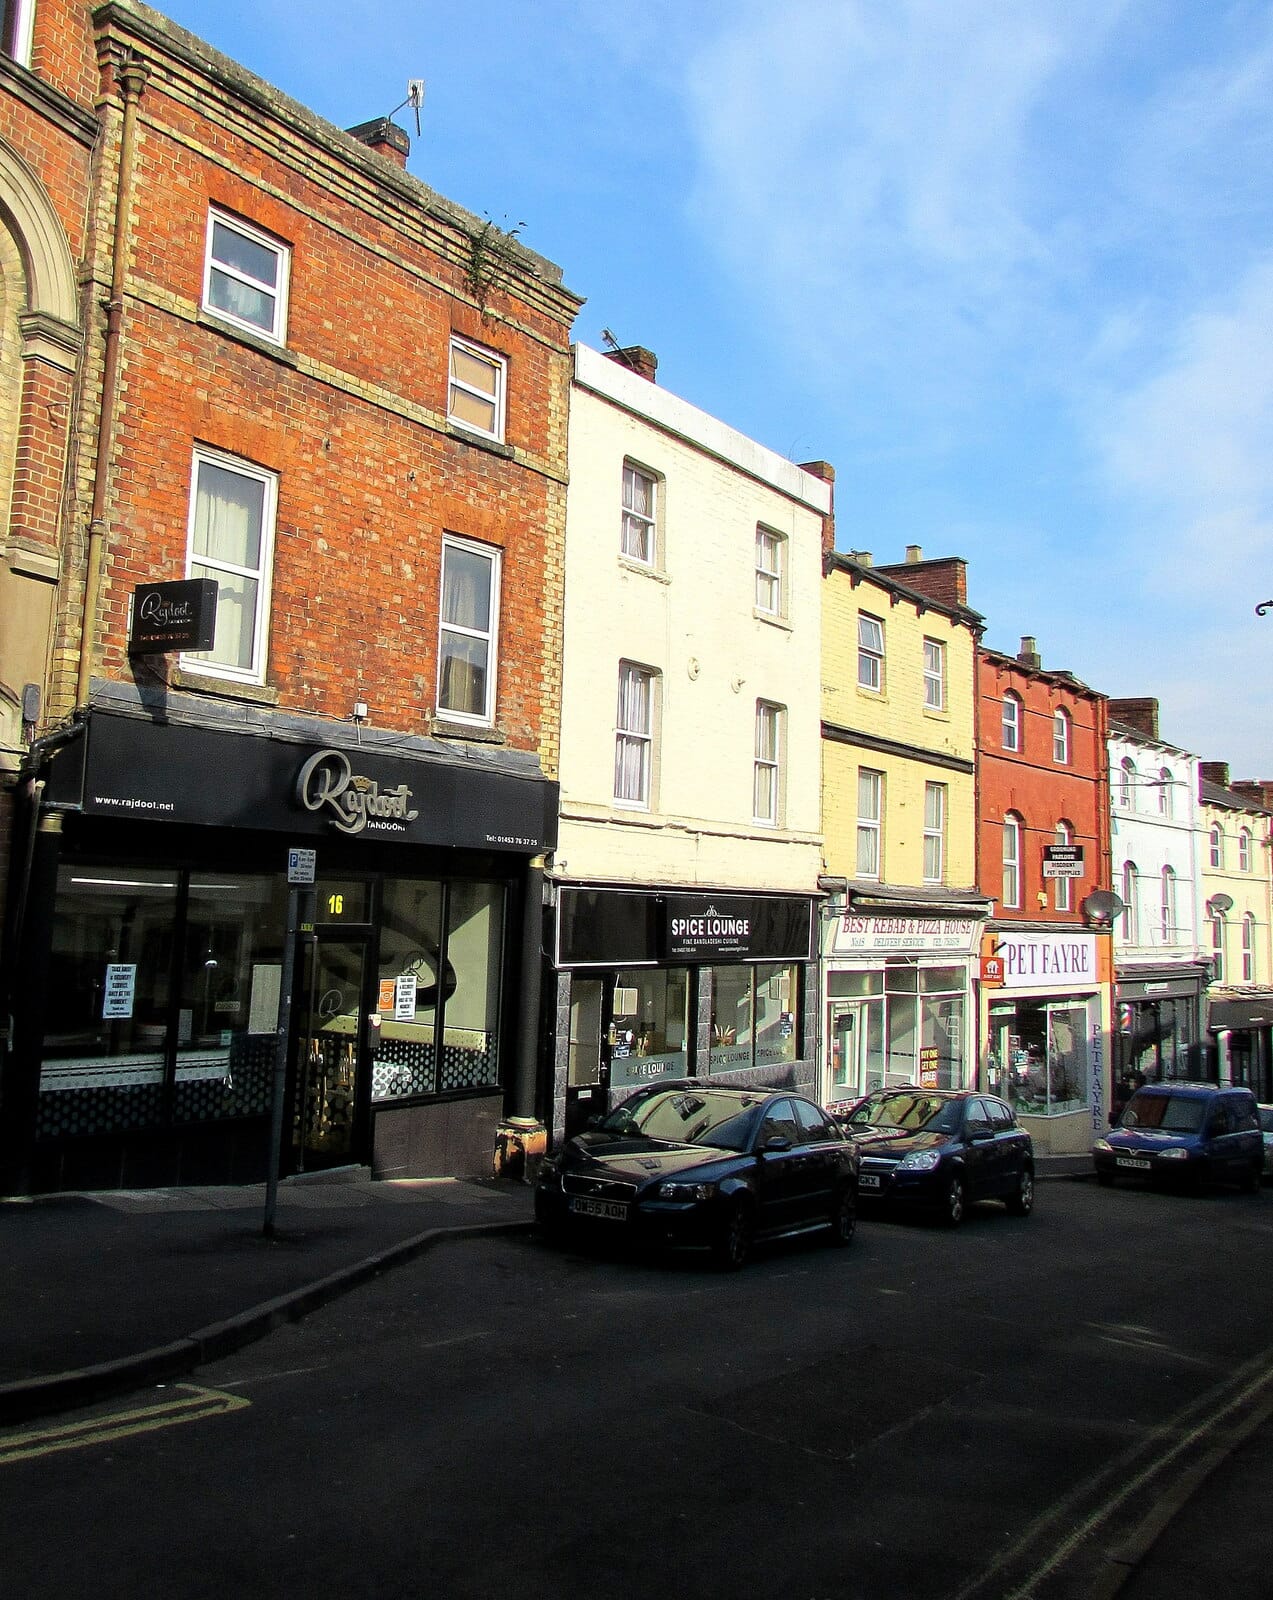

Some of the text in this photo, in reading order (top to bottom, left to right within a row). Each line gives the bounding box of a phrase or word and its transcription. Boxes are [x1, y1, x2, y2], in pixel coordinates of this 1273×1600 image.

[297, 749, 418, 834] Rajdoot
[95, 796, 174, 811] www.rajdoot.net
[328, 894, 344, 914] 16
[671, 918, 749, 936] SPICE LOUNGE
[842, 916, 971, 935] BEST KEBAB & PIZZA HOUSE
[1008, 944, 1089, 974] PET FAYRE
